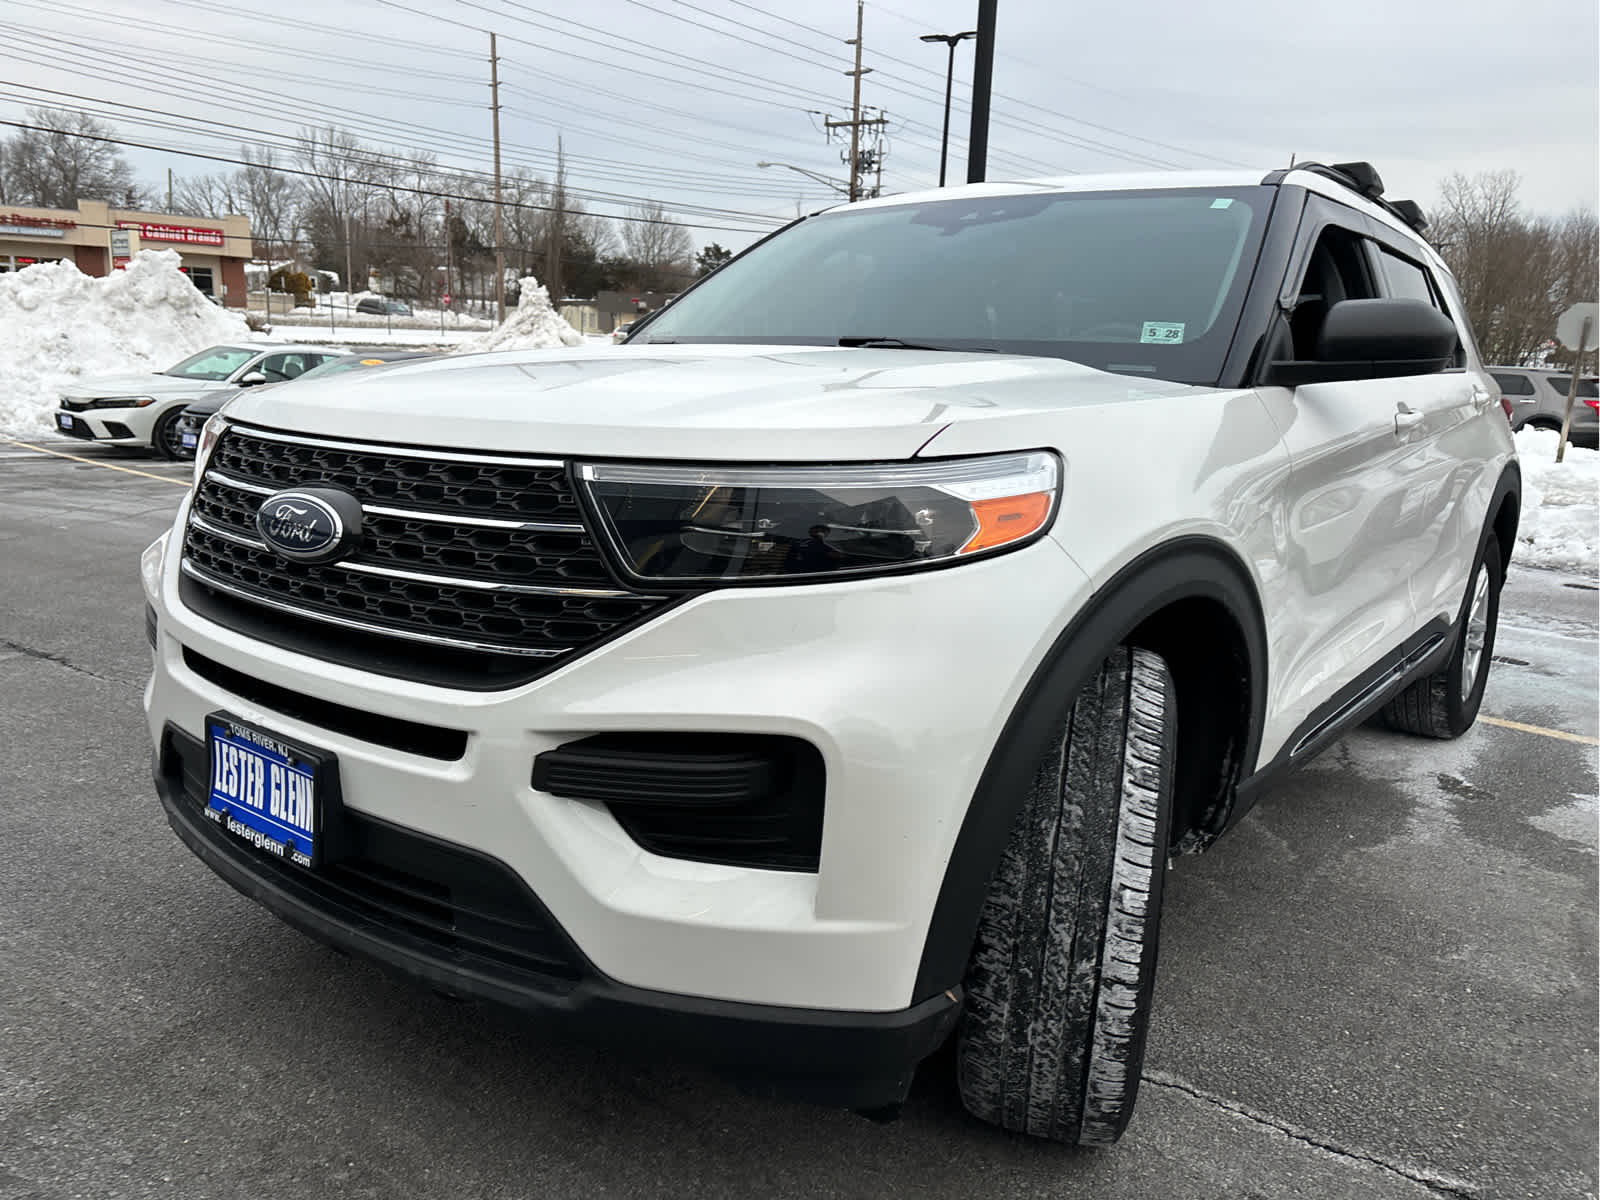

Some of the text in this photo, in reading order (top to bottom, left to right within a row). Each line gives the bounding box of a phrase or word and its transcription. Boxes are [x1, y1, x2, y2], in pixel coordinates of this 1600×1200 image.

[146, 225, 185, 241] Cabinet
[187, 228, 221, 243] Brands
[1148, 328, 1180, 339] 5 28
[269, 504, 317, 542] Ford
[230, 723, 251, 742] TOMS
[277, 743, 289, 757] NJ
[214, 740, 314, 833] LESTER GLENN
[226, 816, 285, 857] lesterglenn
[291, 852, 311, 868] .com
